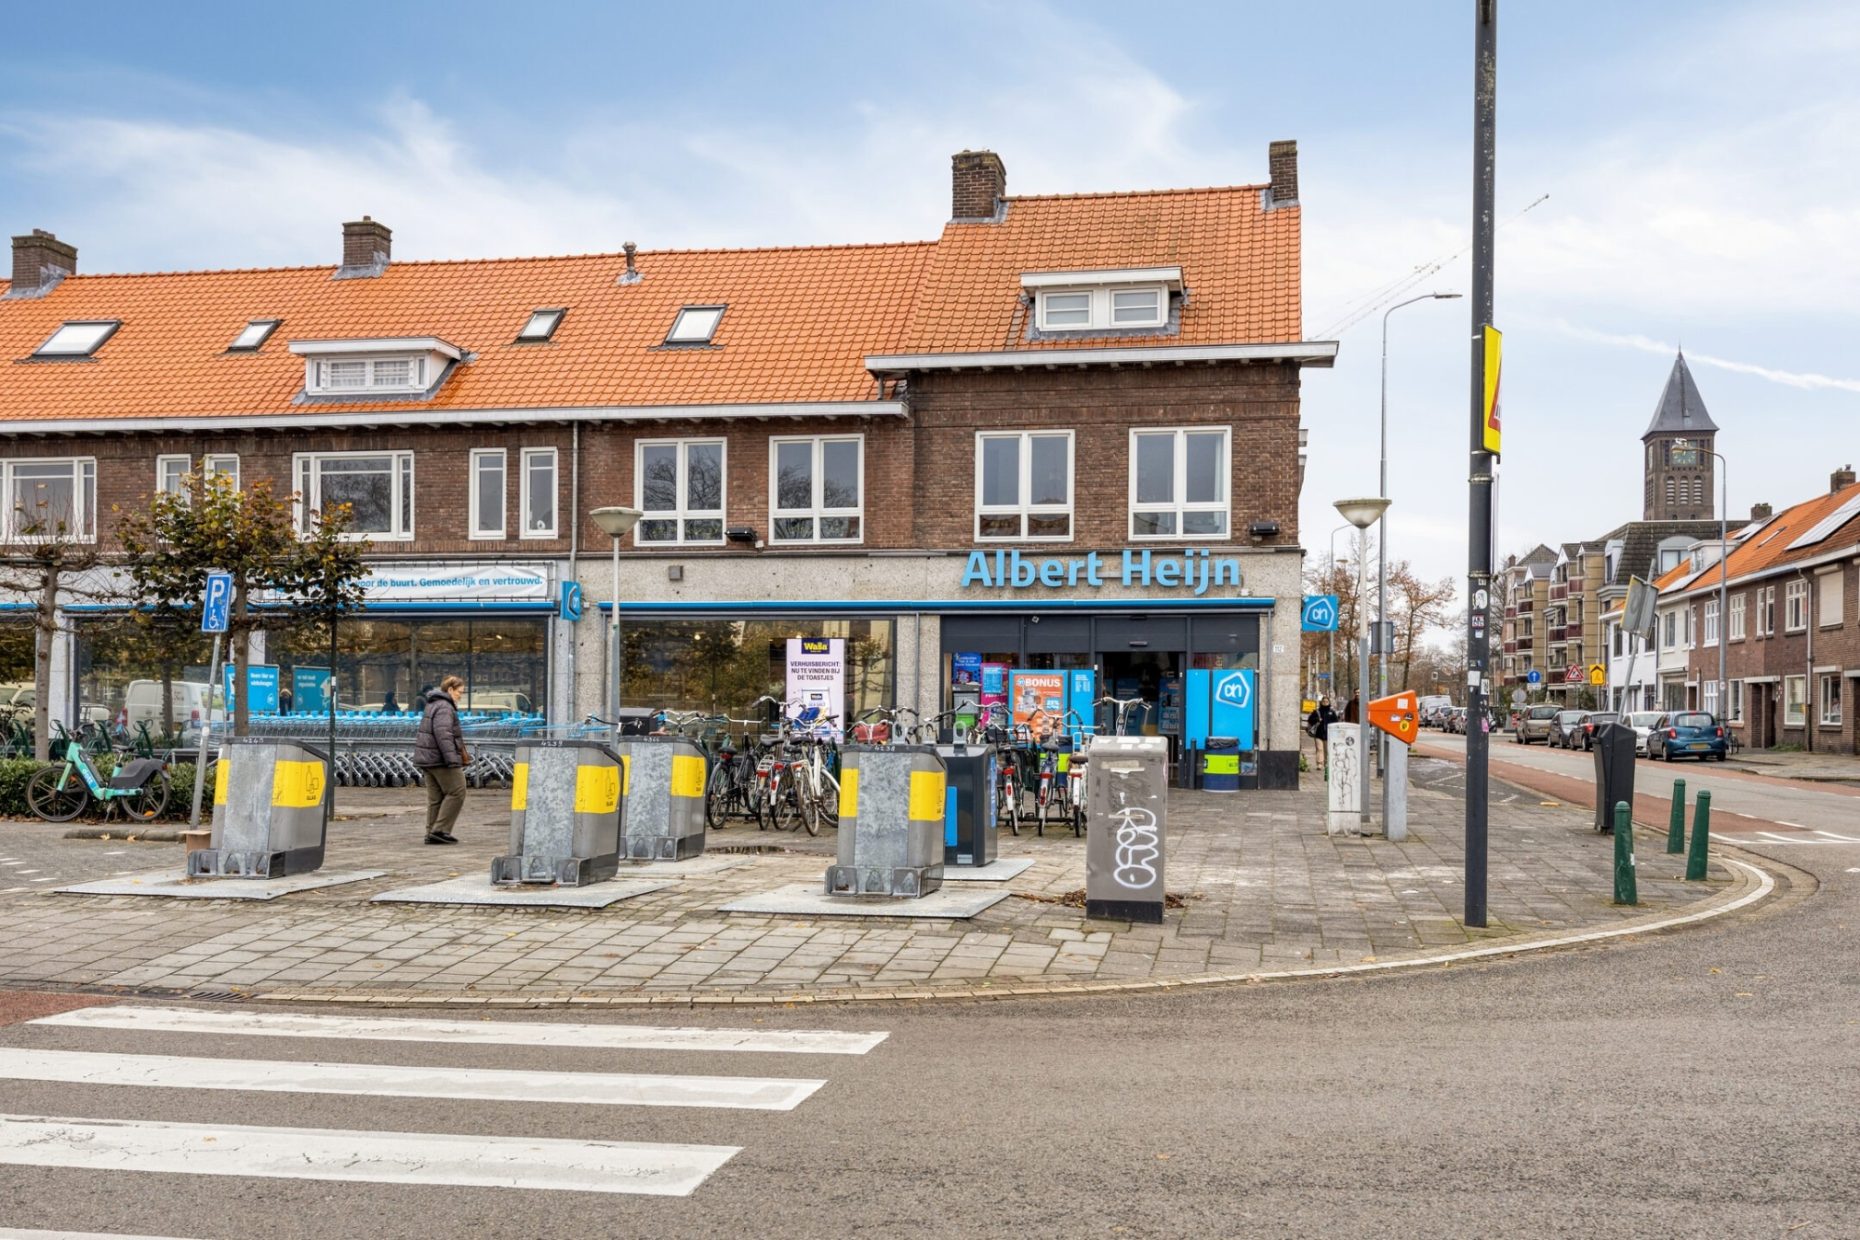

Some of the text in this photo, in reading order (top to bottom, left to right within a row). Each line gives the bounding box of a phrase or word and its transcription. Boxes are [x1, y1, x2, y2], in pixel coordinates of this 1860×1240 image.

[377, 578, 389, 587] de
[390, 578, 418, 587] buurt.
[419, 577, 476, 588] Gemoedelijk
[478, 578, 490, 586] en
[492, 576, 543, 586] vertrouwd.
[960, 548, 1240, 596] Albert Heijn
[210, 579, 225, 608] P
[1025, 678, 1061, 687] BONUS
